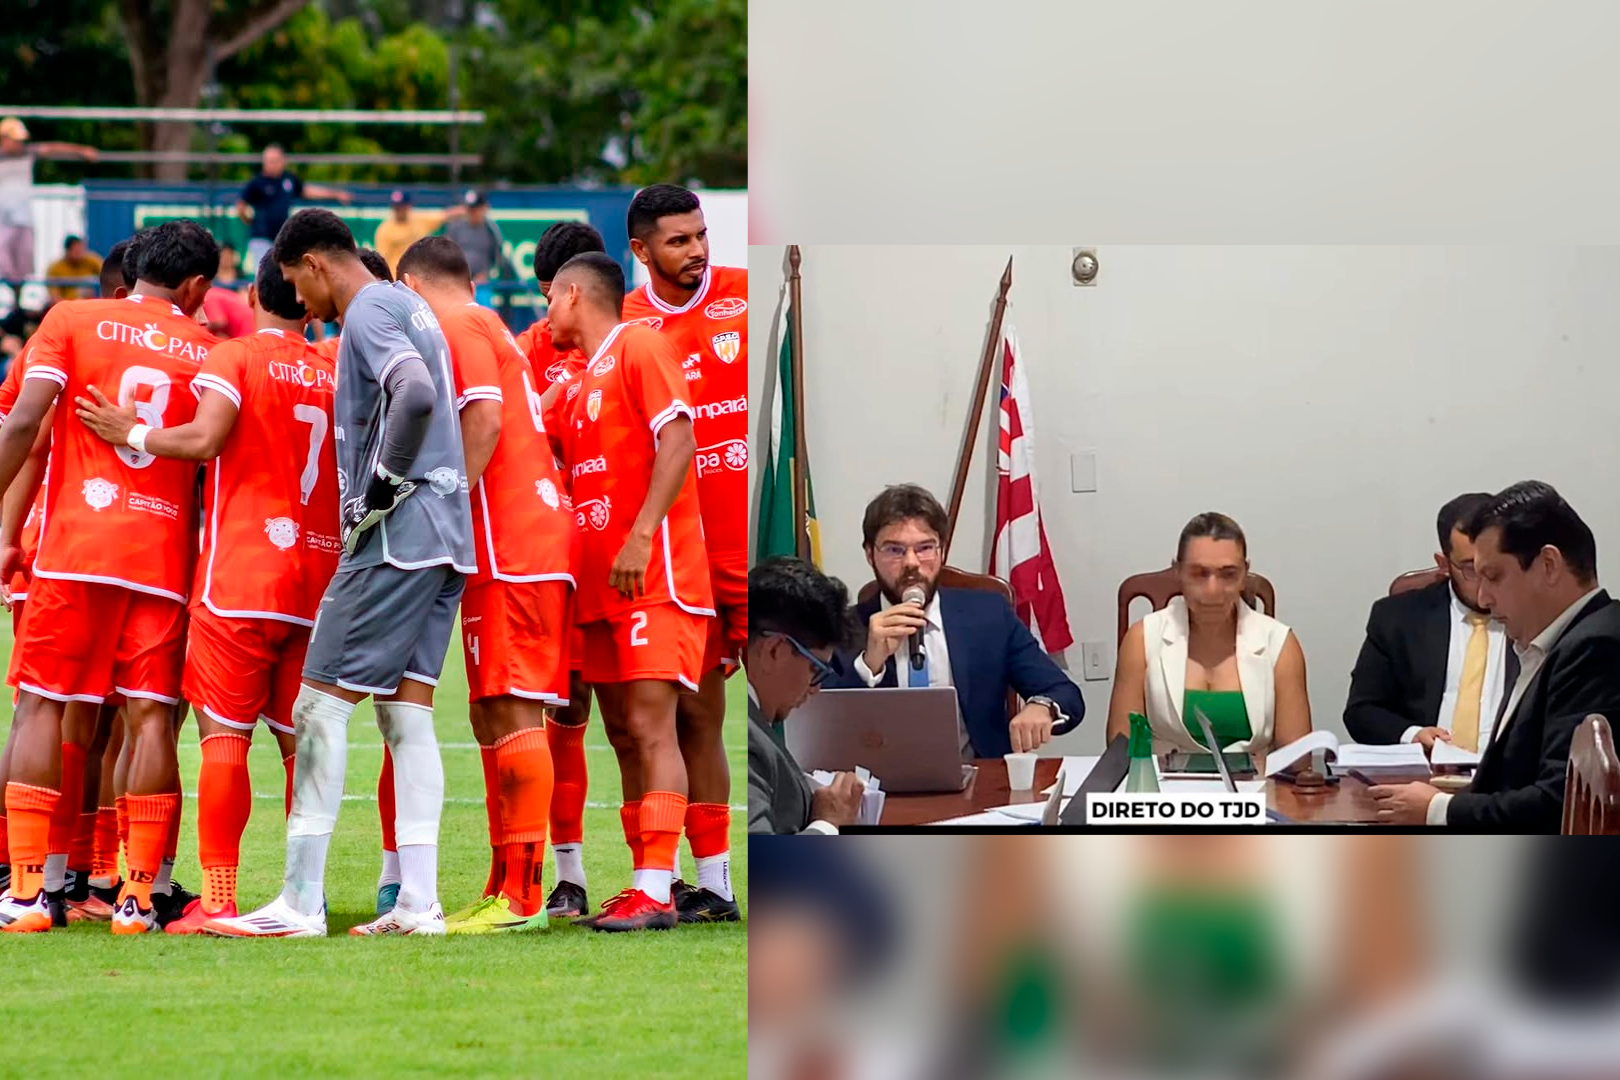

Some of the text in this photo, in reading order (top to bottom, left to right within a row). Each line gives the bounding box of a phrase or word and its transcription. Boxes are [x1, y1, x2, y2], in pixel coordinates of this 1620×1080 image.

[293, 403, 328, 506] 7
[630, 611, 649, 647] 2
[467, 632, 480, 666] 4
